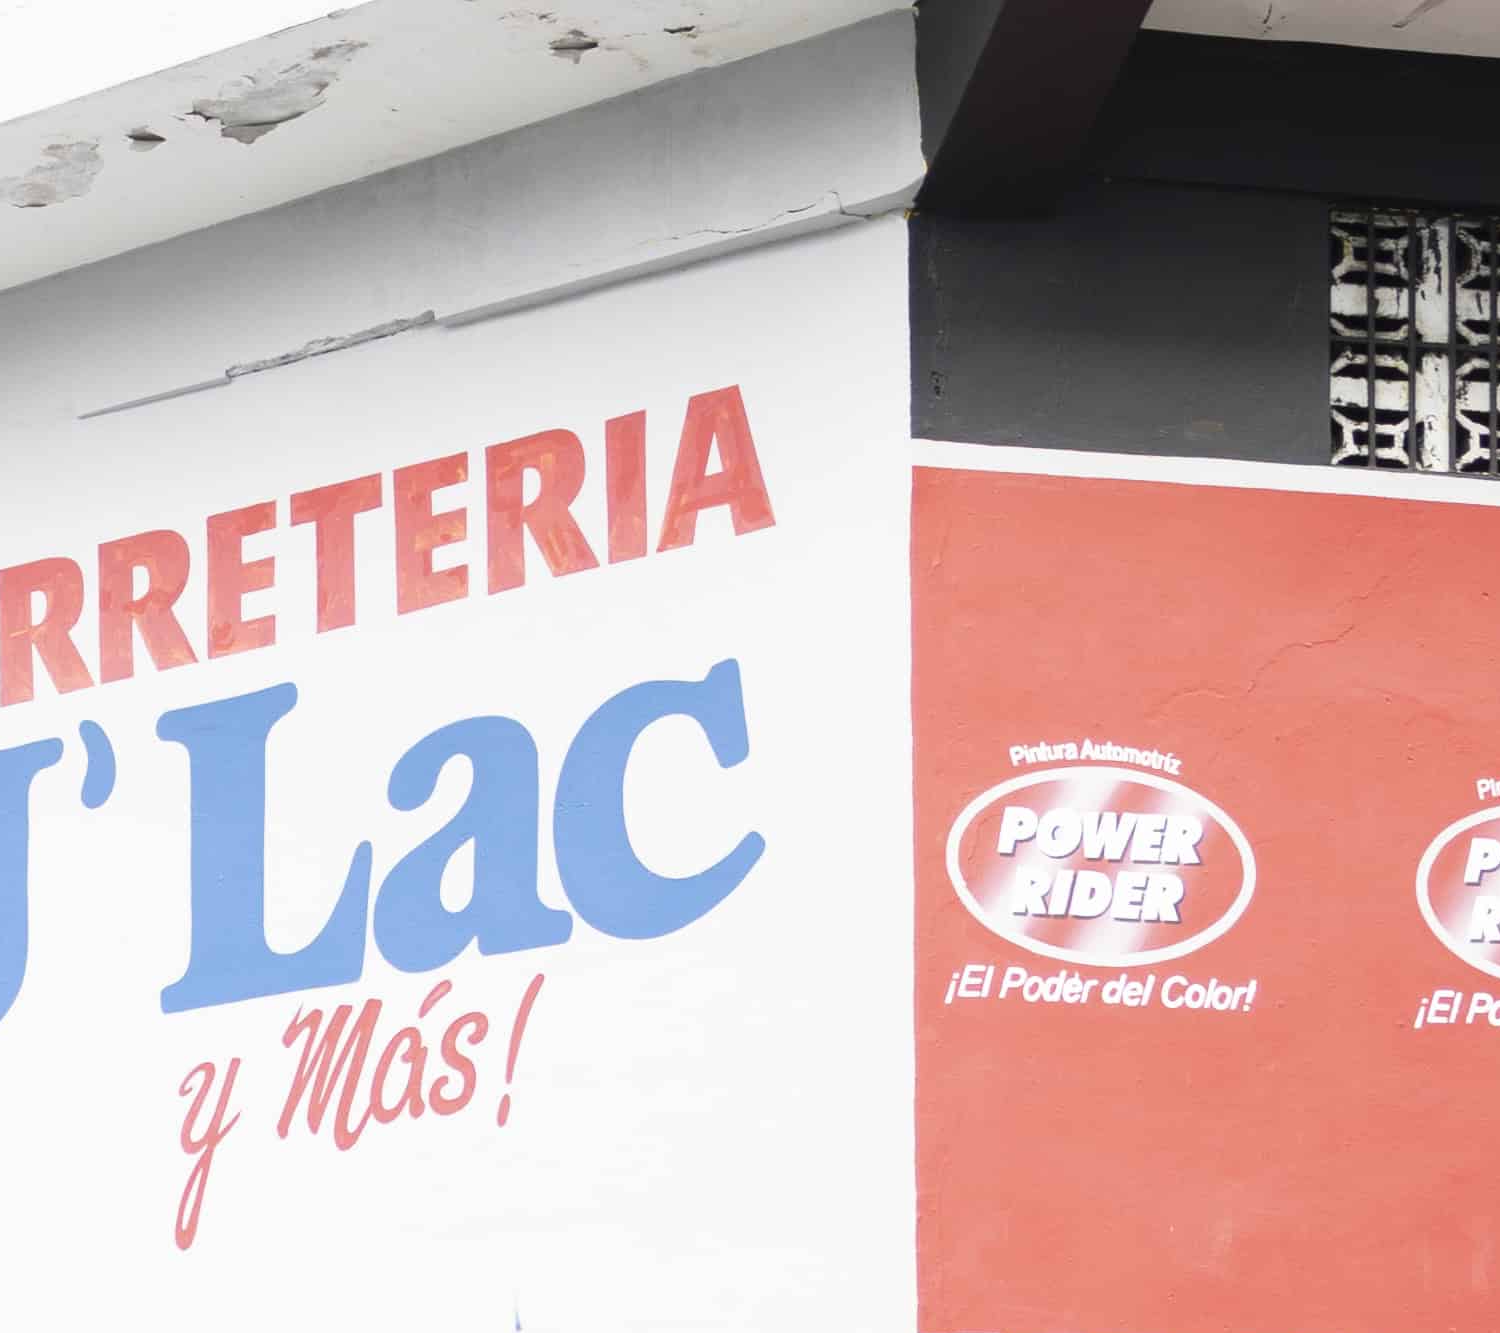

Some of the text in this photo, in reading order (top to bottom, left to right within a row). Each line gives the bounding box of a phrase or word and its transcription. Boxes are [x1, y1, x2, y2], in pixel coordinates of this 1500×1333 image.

[1009, 741, 1078, 766] Pintura
[997, 806, 1204, 865] POWER
[1013, 866, 1185, 924] RIDER
[945, 964, 1257, 1012] ¡El Poder del Color!
[1413, 989, 1463, 1029] ¡El
[174, 970, 546, 1251] y Más!
